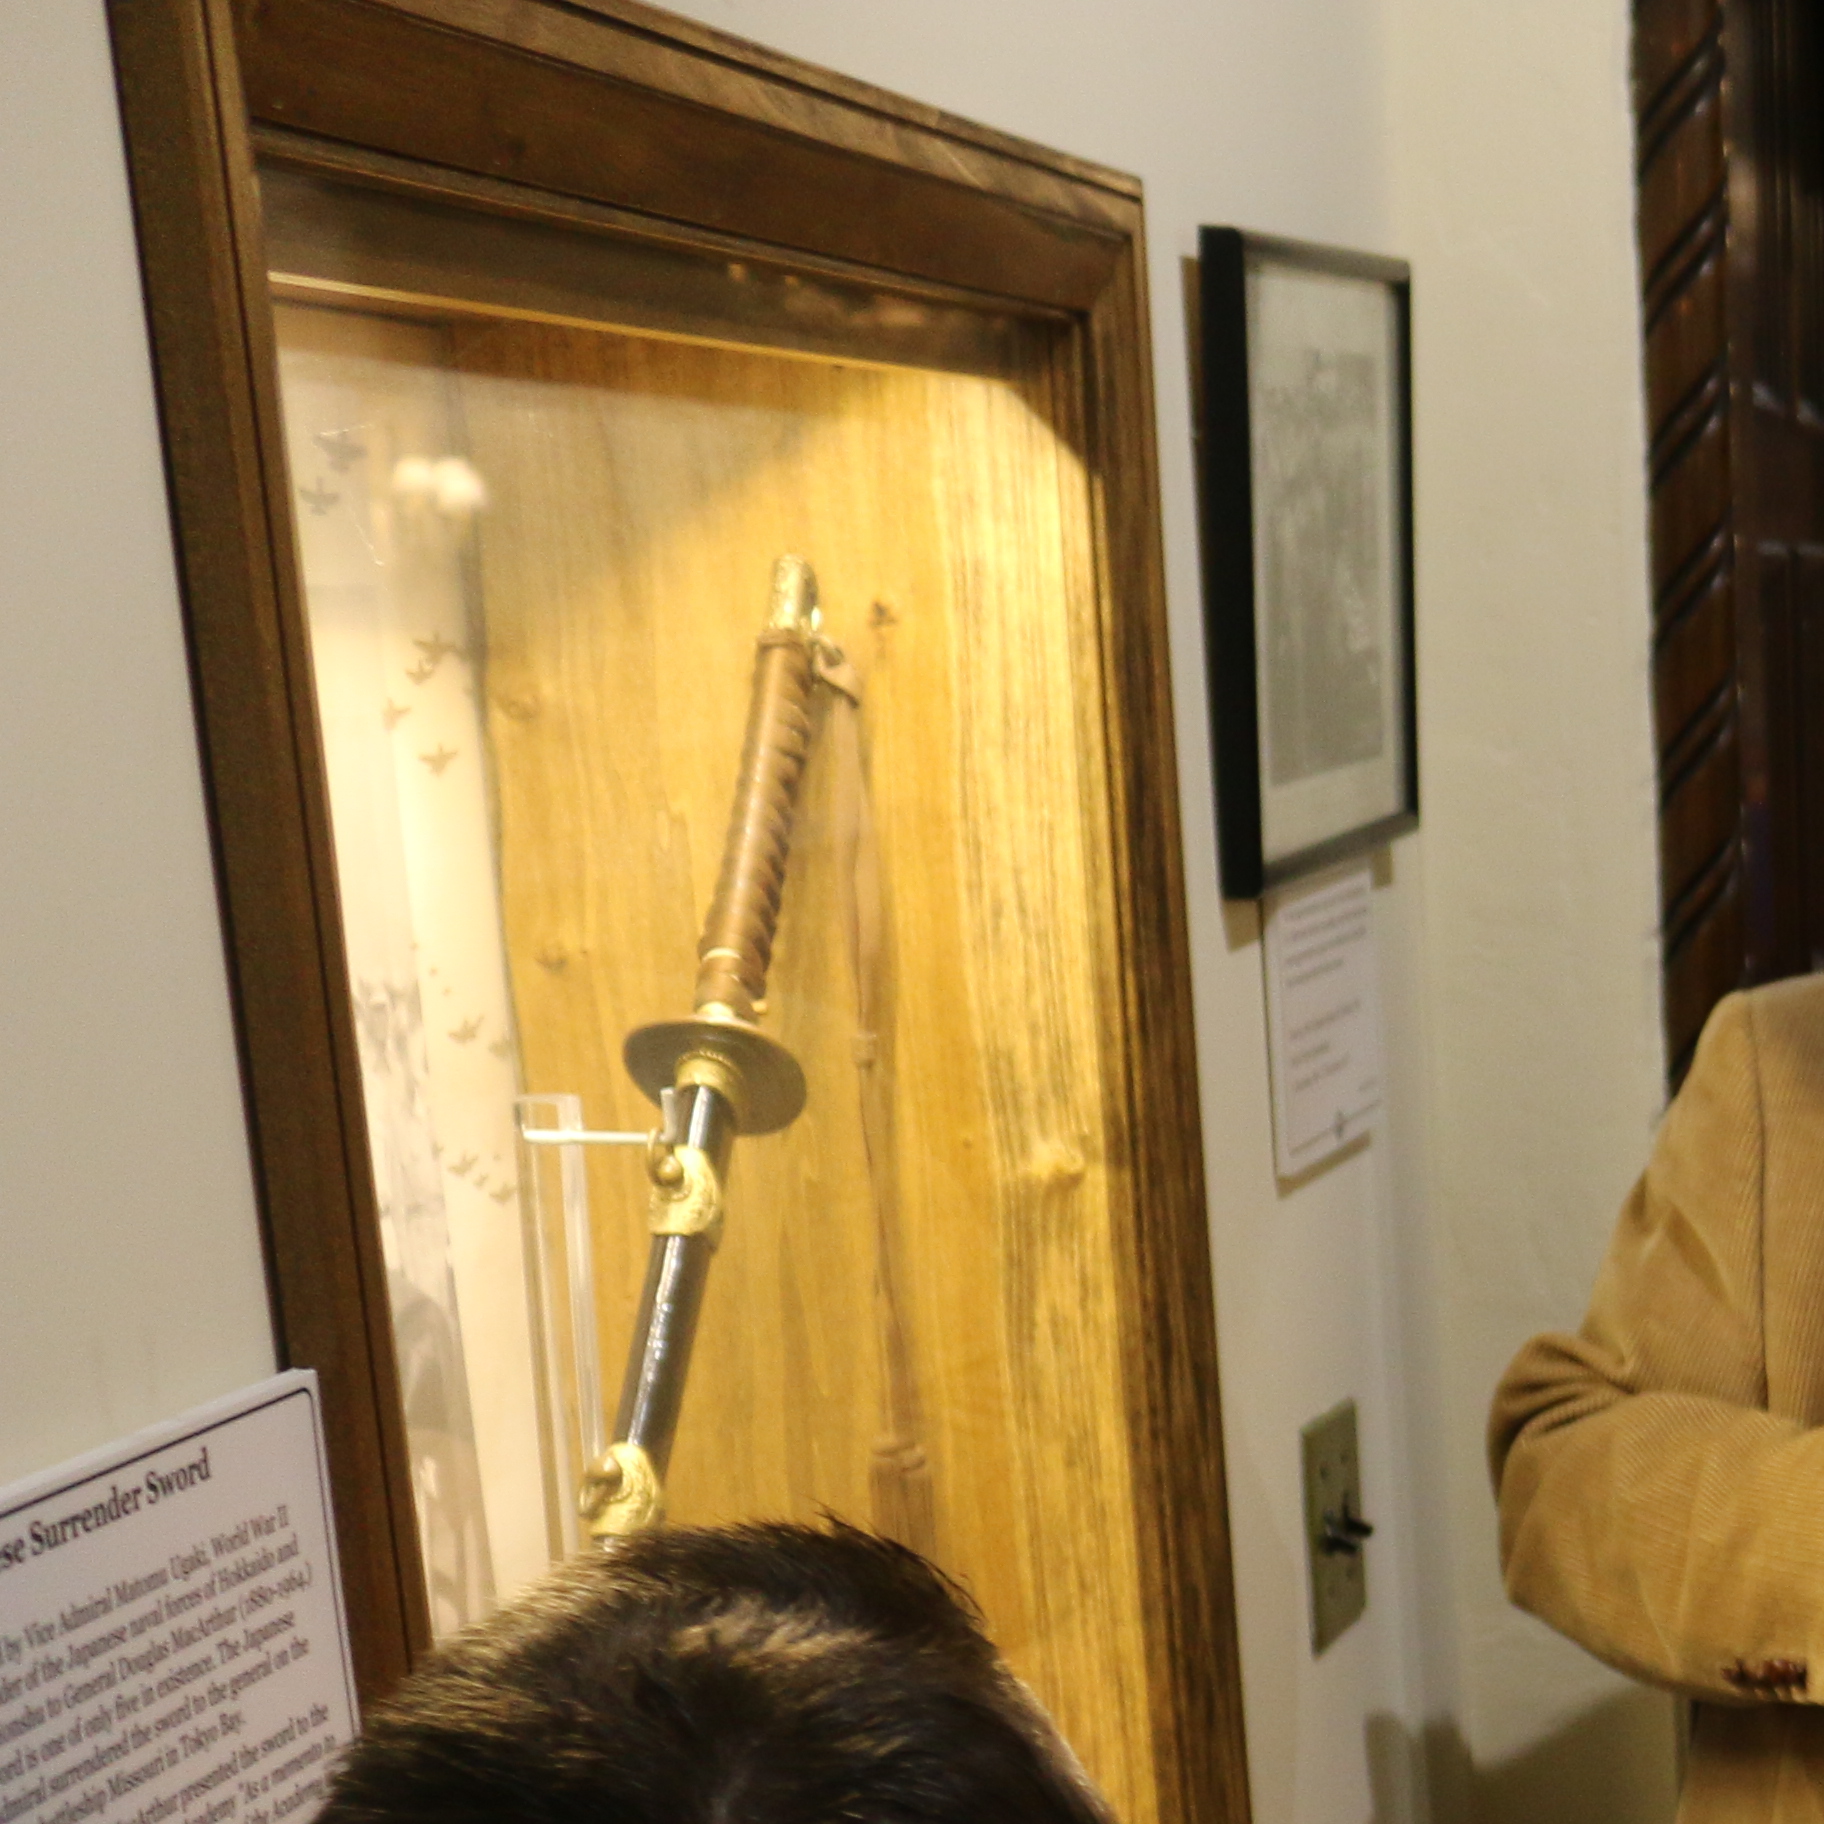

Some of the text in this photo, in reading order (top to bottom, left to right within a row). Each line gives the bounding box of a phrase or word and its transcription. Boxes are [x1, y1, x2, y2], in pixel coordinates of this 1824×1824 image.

[29, 1485, 142, 1556] Surrender
[145, 1446, 211, 1505] Sword
[23, 1622, 56, 1648] Vice
[59, 1587, 113, 1636] Admiral
[210, 1521, 250, 1558] World
[249, 1515, 276, 1539] War
[24, 1661, 40, 1691] of
[40, 1656, 64, 1682] the
[67, 1625, 128, 1670] Japanese
[129, 1599, 164, 1638] naval
[164, 1588, 203, 1619] forces
[203, 1572, 217, 1600] of
[217, 1548, 275, 1593] Hokkaido
[277, 1533, 300, 1564] and
[41, 1734, 66, 1762] one
[67, 1716, 83, 1747] of
[83, 1704, 112, 1738] only
[114, 1694, 140, 1721] five
[141, 1686, 156, 1708] in
[216, 1638, 241, 1665] The
[243, 1611, 295, 1652] Japanese
[45, 1697, 63, 1719] to
[63, 1661, 118, 1710] General
[117, 1641, 170, 1682] Douglas
[170, 1605, 237, 1654] MacArthur
[49, 1730, 130, 1796] surrendered
[130, 1724, 152, 1750] the
[154, 1696, 192, 1737] sword
[192, 1695, 207, 1715] to
[207, 1681, 228, 1707] the
[229, 1651, 273, 1701] general
[274, 1649, 290, 1670] on
[290, 1636, 309, 1660] the
[106, 1756, 165, 1801] Missouri
[165, 1747, 180, 1768] in
[178, 1725, 219, 1758] Tokyo
[179, 1751, 239, 1813] presented
[239, 1745, 259, 1770] the
[260, 1717, 296, 1754] sword
[295, 1716, 310, 1736] to
[309, 1704, 329, 1727] the
